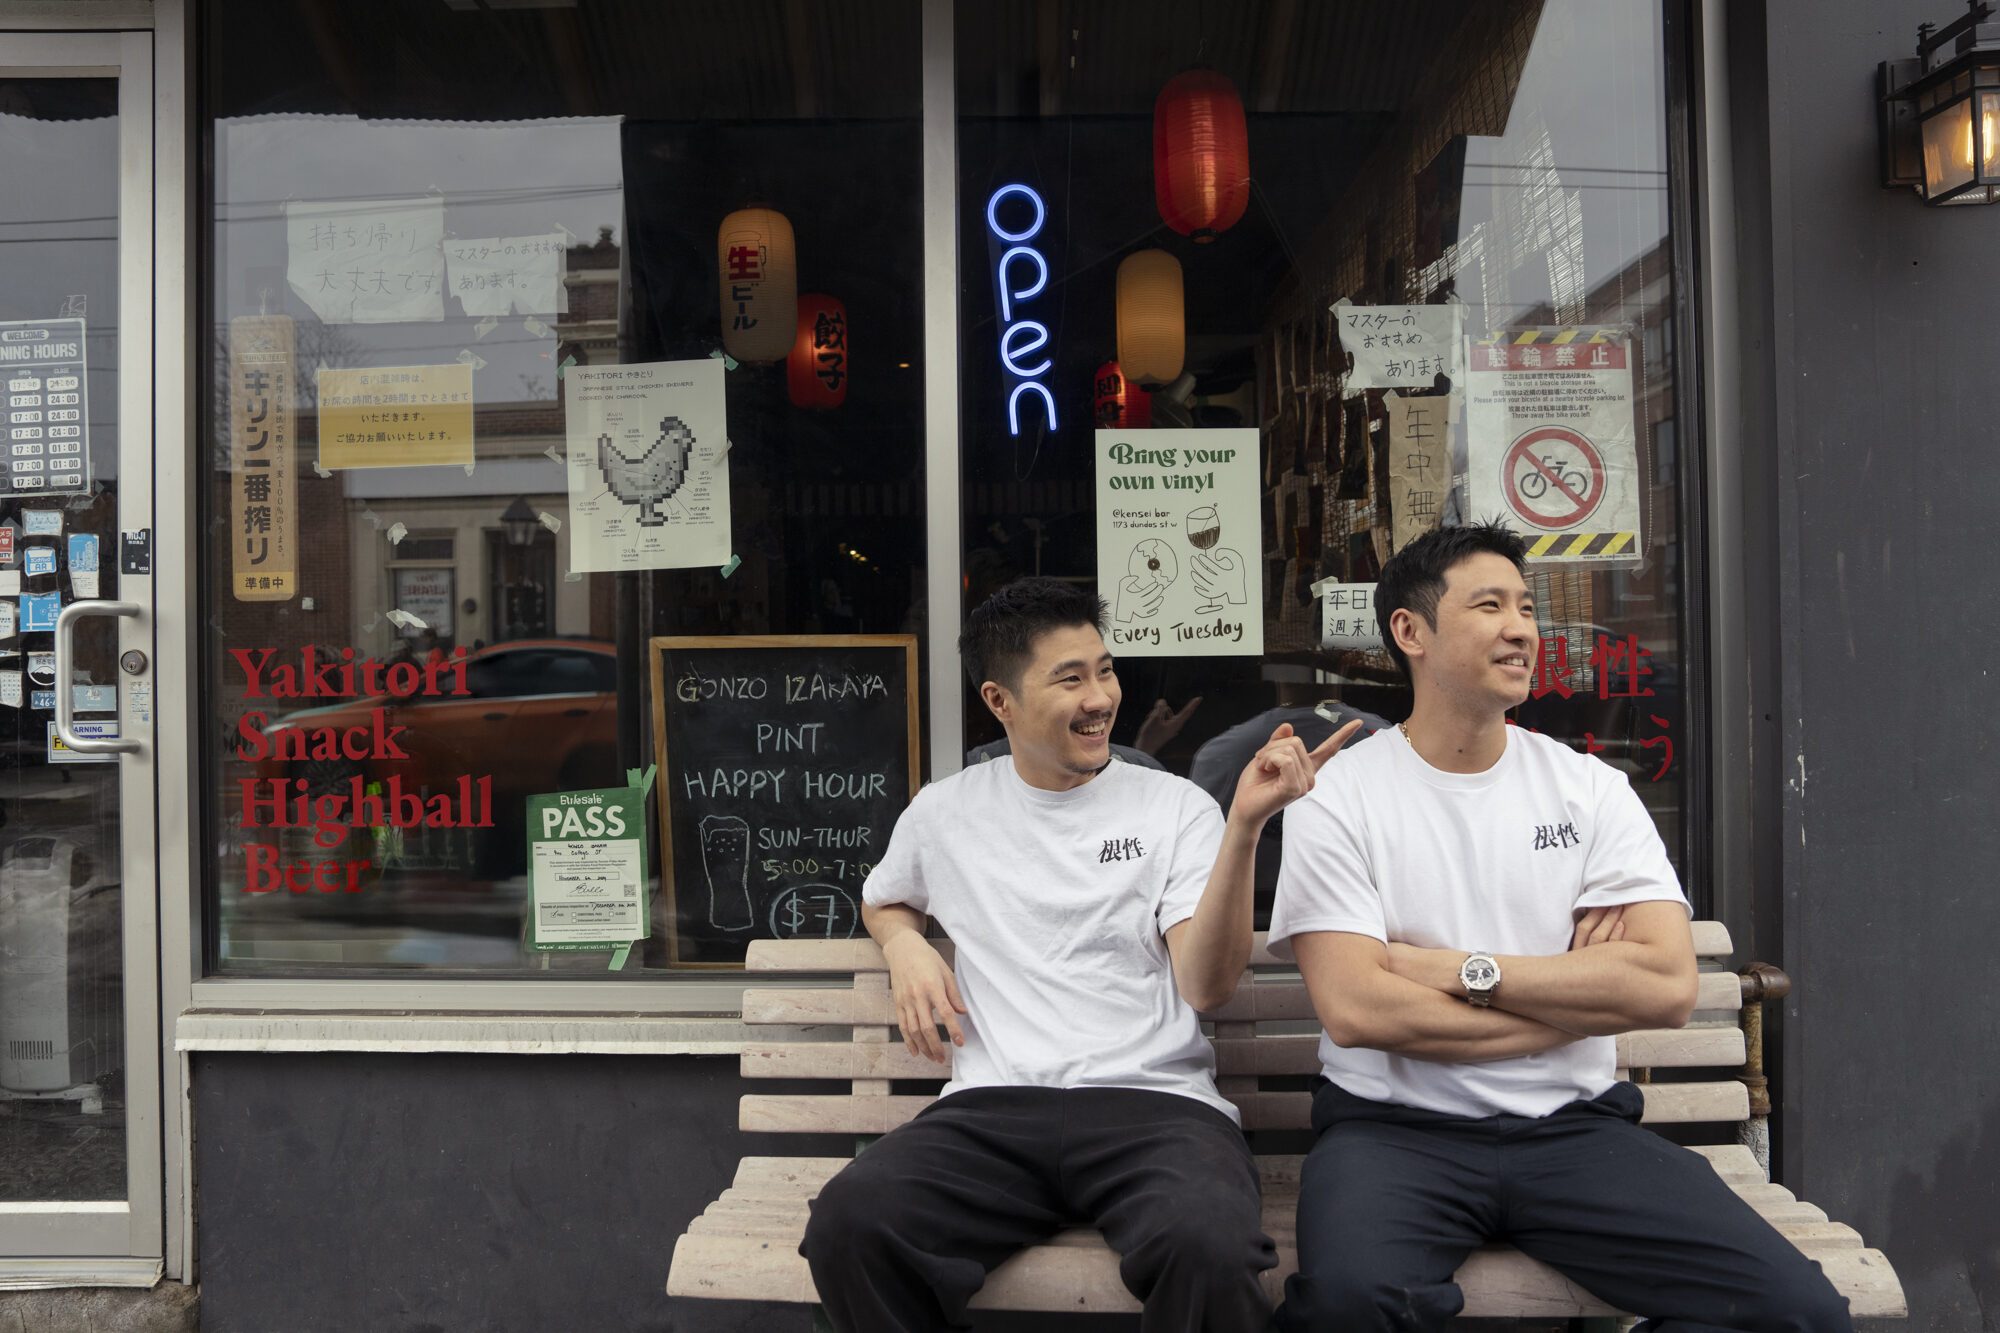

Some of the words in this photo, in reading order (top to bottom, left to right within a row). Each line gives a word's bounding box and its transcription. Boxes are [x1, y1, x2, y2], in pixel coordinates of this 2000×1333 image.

[307, 220, 417, 253] 持ち帰り
[727, 246, 761, 331] 生ビール
[1346, 312, 1417, 331] マスターの
[7, 330, 45, 340] WELCOME
[1363, 331, 1423, 349] おすすめ
[33, 343, 77, 359] HOURS
[813, 311, 846, 391] 餃子
[1488, 345, 1610, 367] 駐輪禁止
[577, 371, 623, 380] YAKITORI
[1385, 353, 1456, 378] あります。
[13, 396, 39, 406] 17:00
[50, 394, 77, 404] 24:00
[14, 412, 40, 422] 17:00
[51, 410, 77, 420] 24:00
[361, 412, 426, 424] いただきます。
[15, 428, 40, 438] 17:00
[51, 427, 78, 437] 24:00
[15, 444, 41, 455] 17:00
[52, 442, 78, 453] 01:00
[1108, 442, 1178, 468] Bring
[1183, 447, 1236, 468] your
[16, 461, 41, 471] 17:00
[52, 458, 78, 469] 01:00
[243, 369, 271, 566] キリン一番搾り
[1404, 404, 1437, 543] 年中無
[17, 477, 42, 487] 17:00
[1109, 474, 1156, 490] own
[1162, 471, 1215, 493] vinyl
[1129, 520, 1158, 529] dundas
[1159, 520, 1168, 528] st
[1154, 507, 1171, 518] bar
[244, 576, 284, 590] 準備中
[1328, 589, 1374, 611] 平日
[1112, 627, 1161, 645] Every
[1170, 617, 1243, 643] Tuesday
[228, 644, 472, 698] Yakitori
[676, 674, 769, 703] GONZO
[784, 673, 889, 705] IZAKAYA
[238, 706, 410, 762] Snack
[757, 722, 826, 756] PINT
[684, 767, 787, 803] HAPPY
[804, 770, 888, 801] HOUR
[237, 774, 496, 848] Highball
[542, 805, 626, 839] PASS
[757, 826, 872, 851] SUN-THUR
[240, 843, 371, 893] Beer
[760, 857, 879, 882] 5:00-7:0
[780, 890, 841, 940] $7
